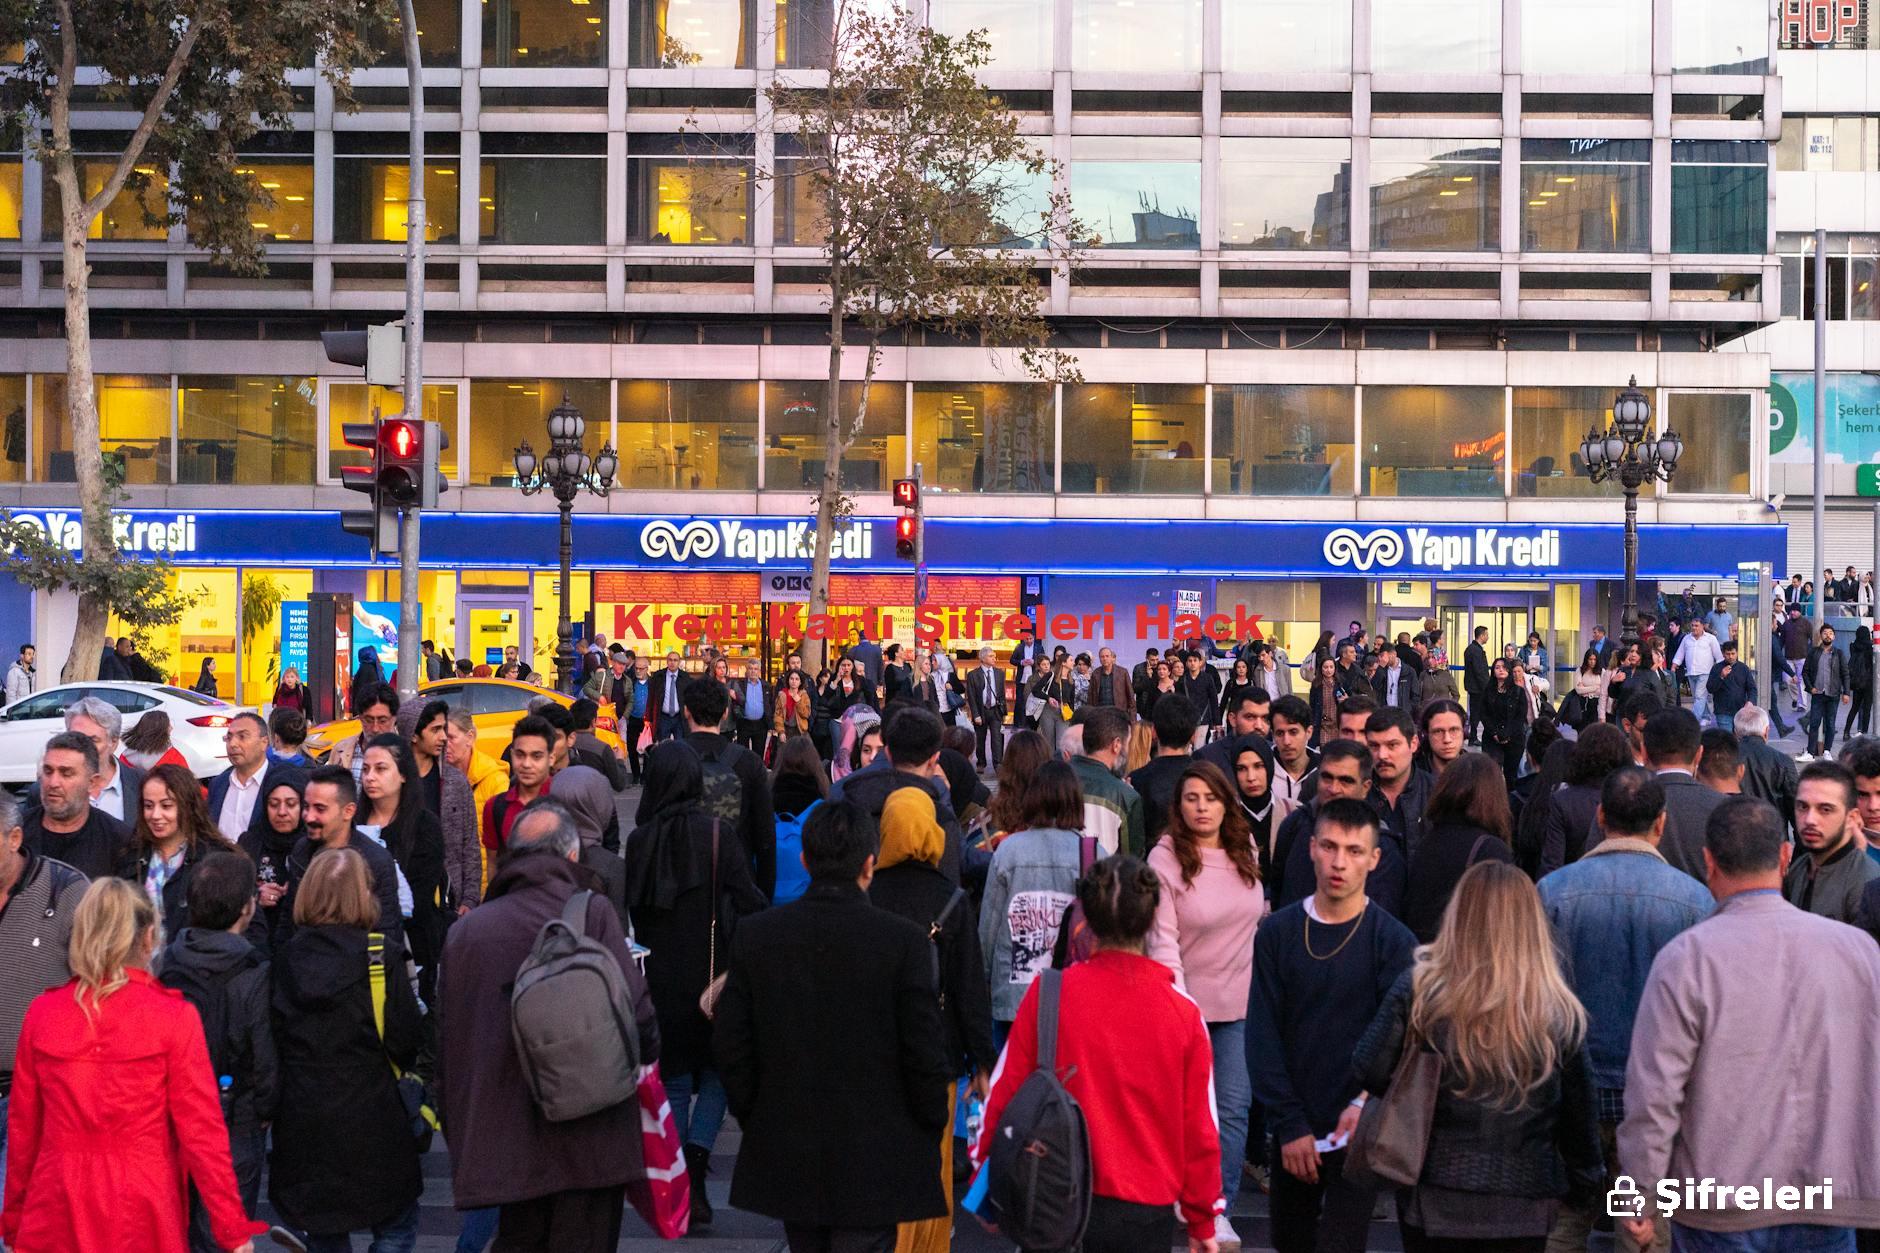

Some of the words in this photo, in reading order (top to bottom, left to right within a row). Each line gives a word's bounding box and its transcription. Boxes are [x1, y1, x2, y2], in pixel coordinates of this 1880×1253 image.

[1810, 145, 1820, 153] NO:
[1846, 421, 1874, 432] hem
[900, 484, 912, 501] 4
[46, 513, 82, 550] Ya
[719, 521, 785, 564] Yapı
[1406, 528, 1471, 571] Yapı
[1475, 528, 1559, 567] Kredi
[1763, 566, 1770, 576] 2
